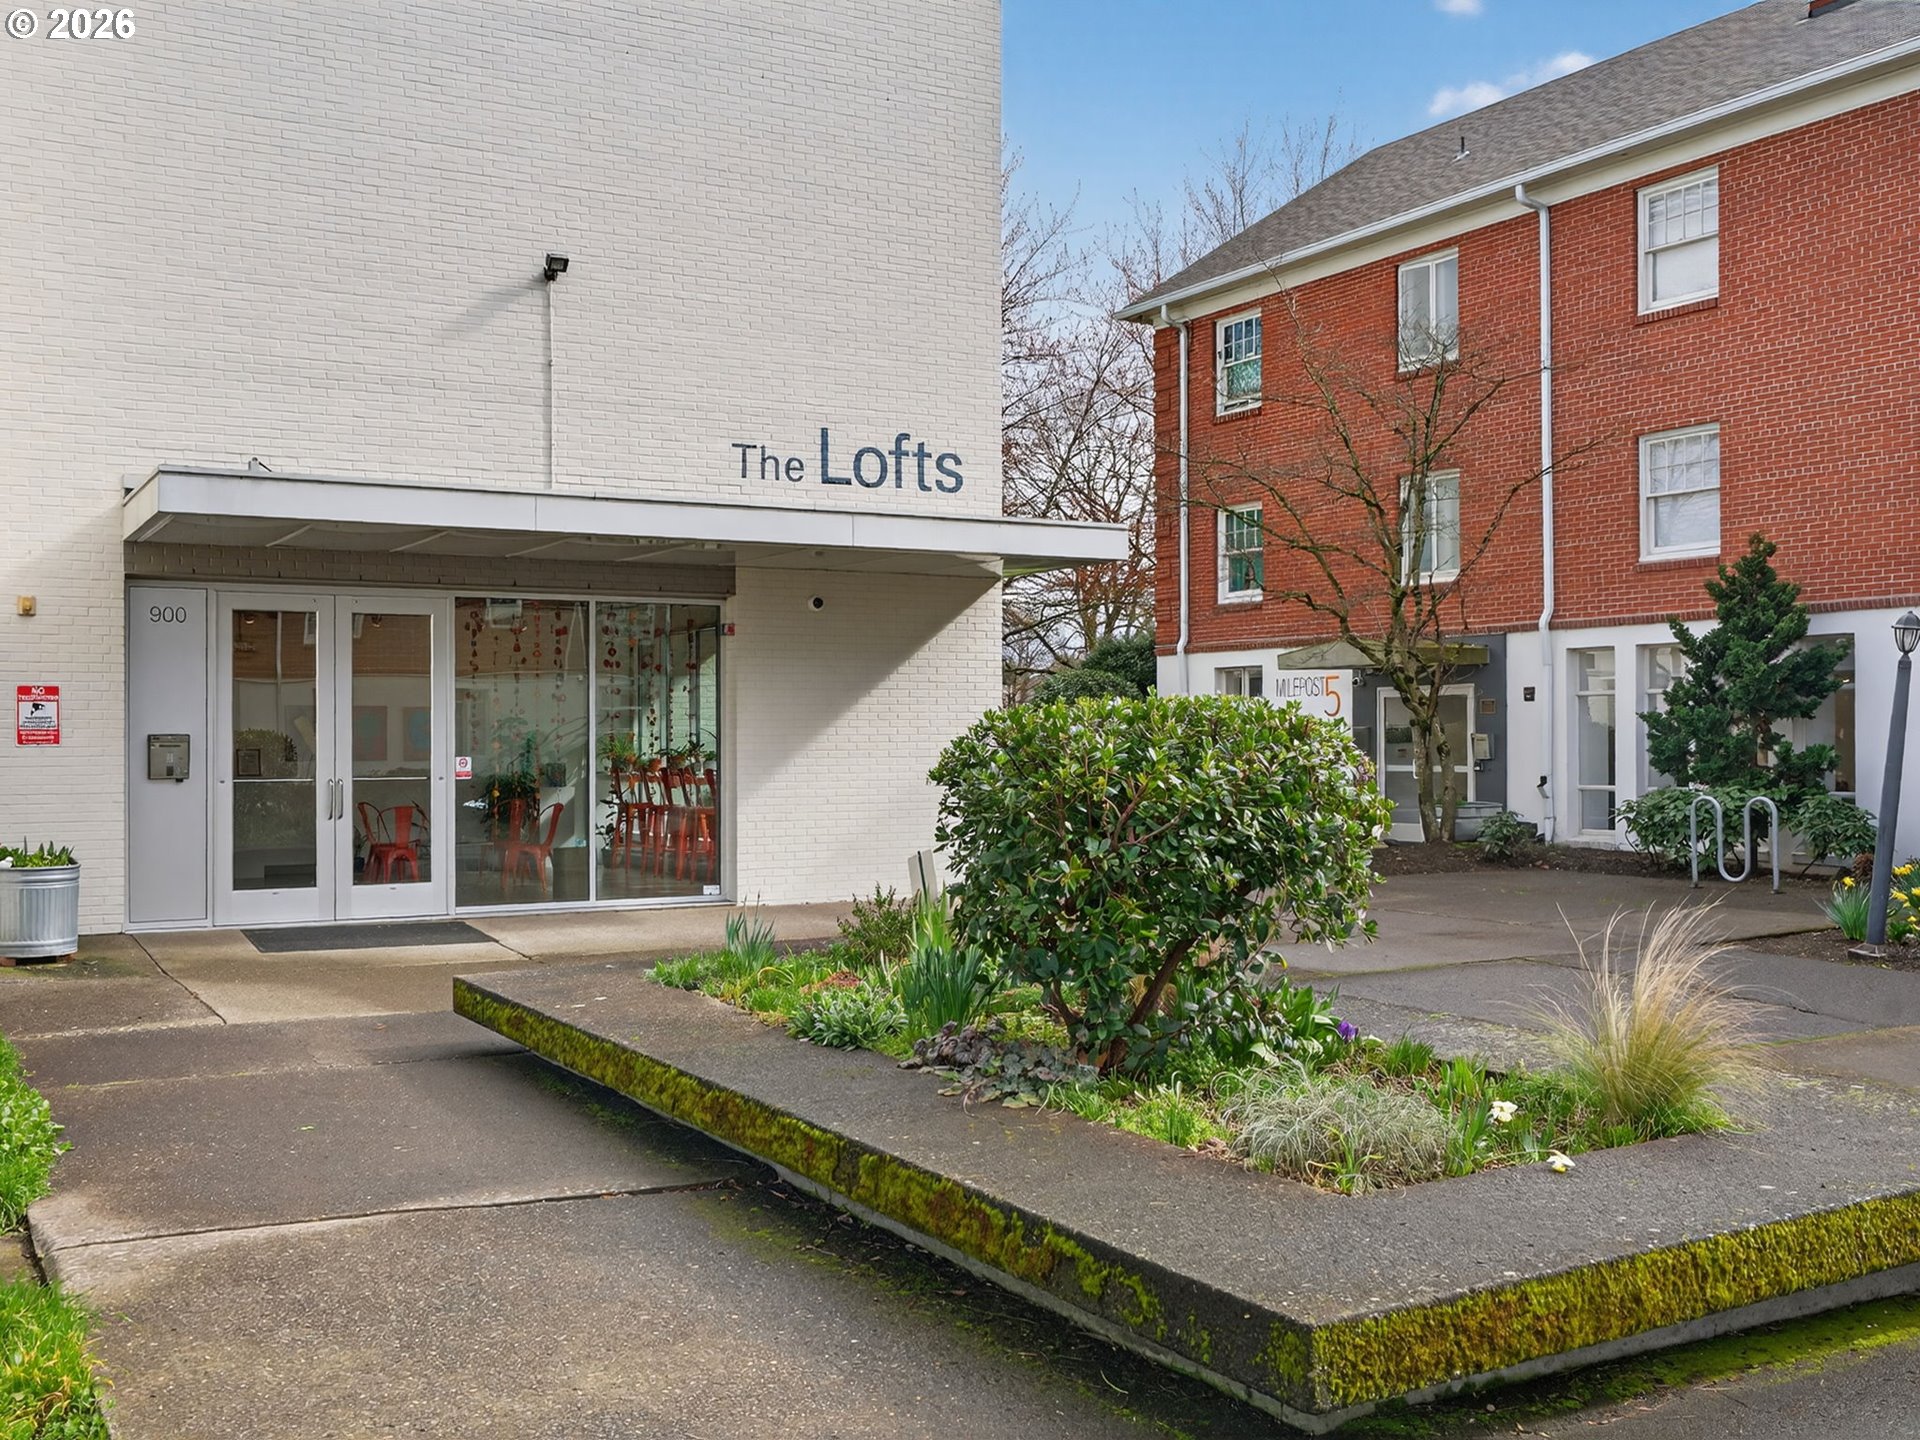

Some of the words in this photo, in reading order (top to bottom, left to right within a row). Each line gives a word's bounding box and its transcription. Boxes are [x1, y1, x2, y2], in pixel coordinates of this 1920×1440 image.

[731, 443, 805, 482] The
[821, 427, 964, 493] Lofts
[150, 606, 187, 623] 900
[31, 686, 46, 695] NO
[1324, 675, 1341, 717] 5
